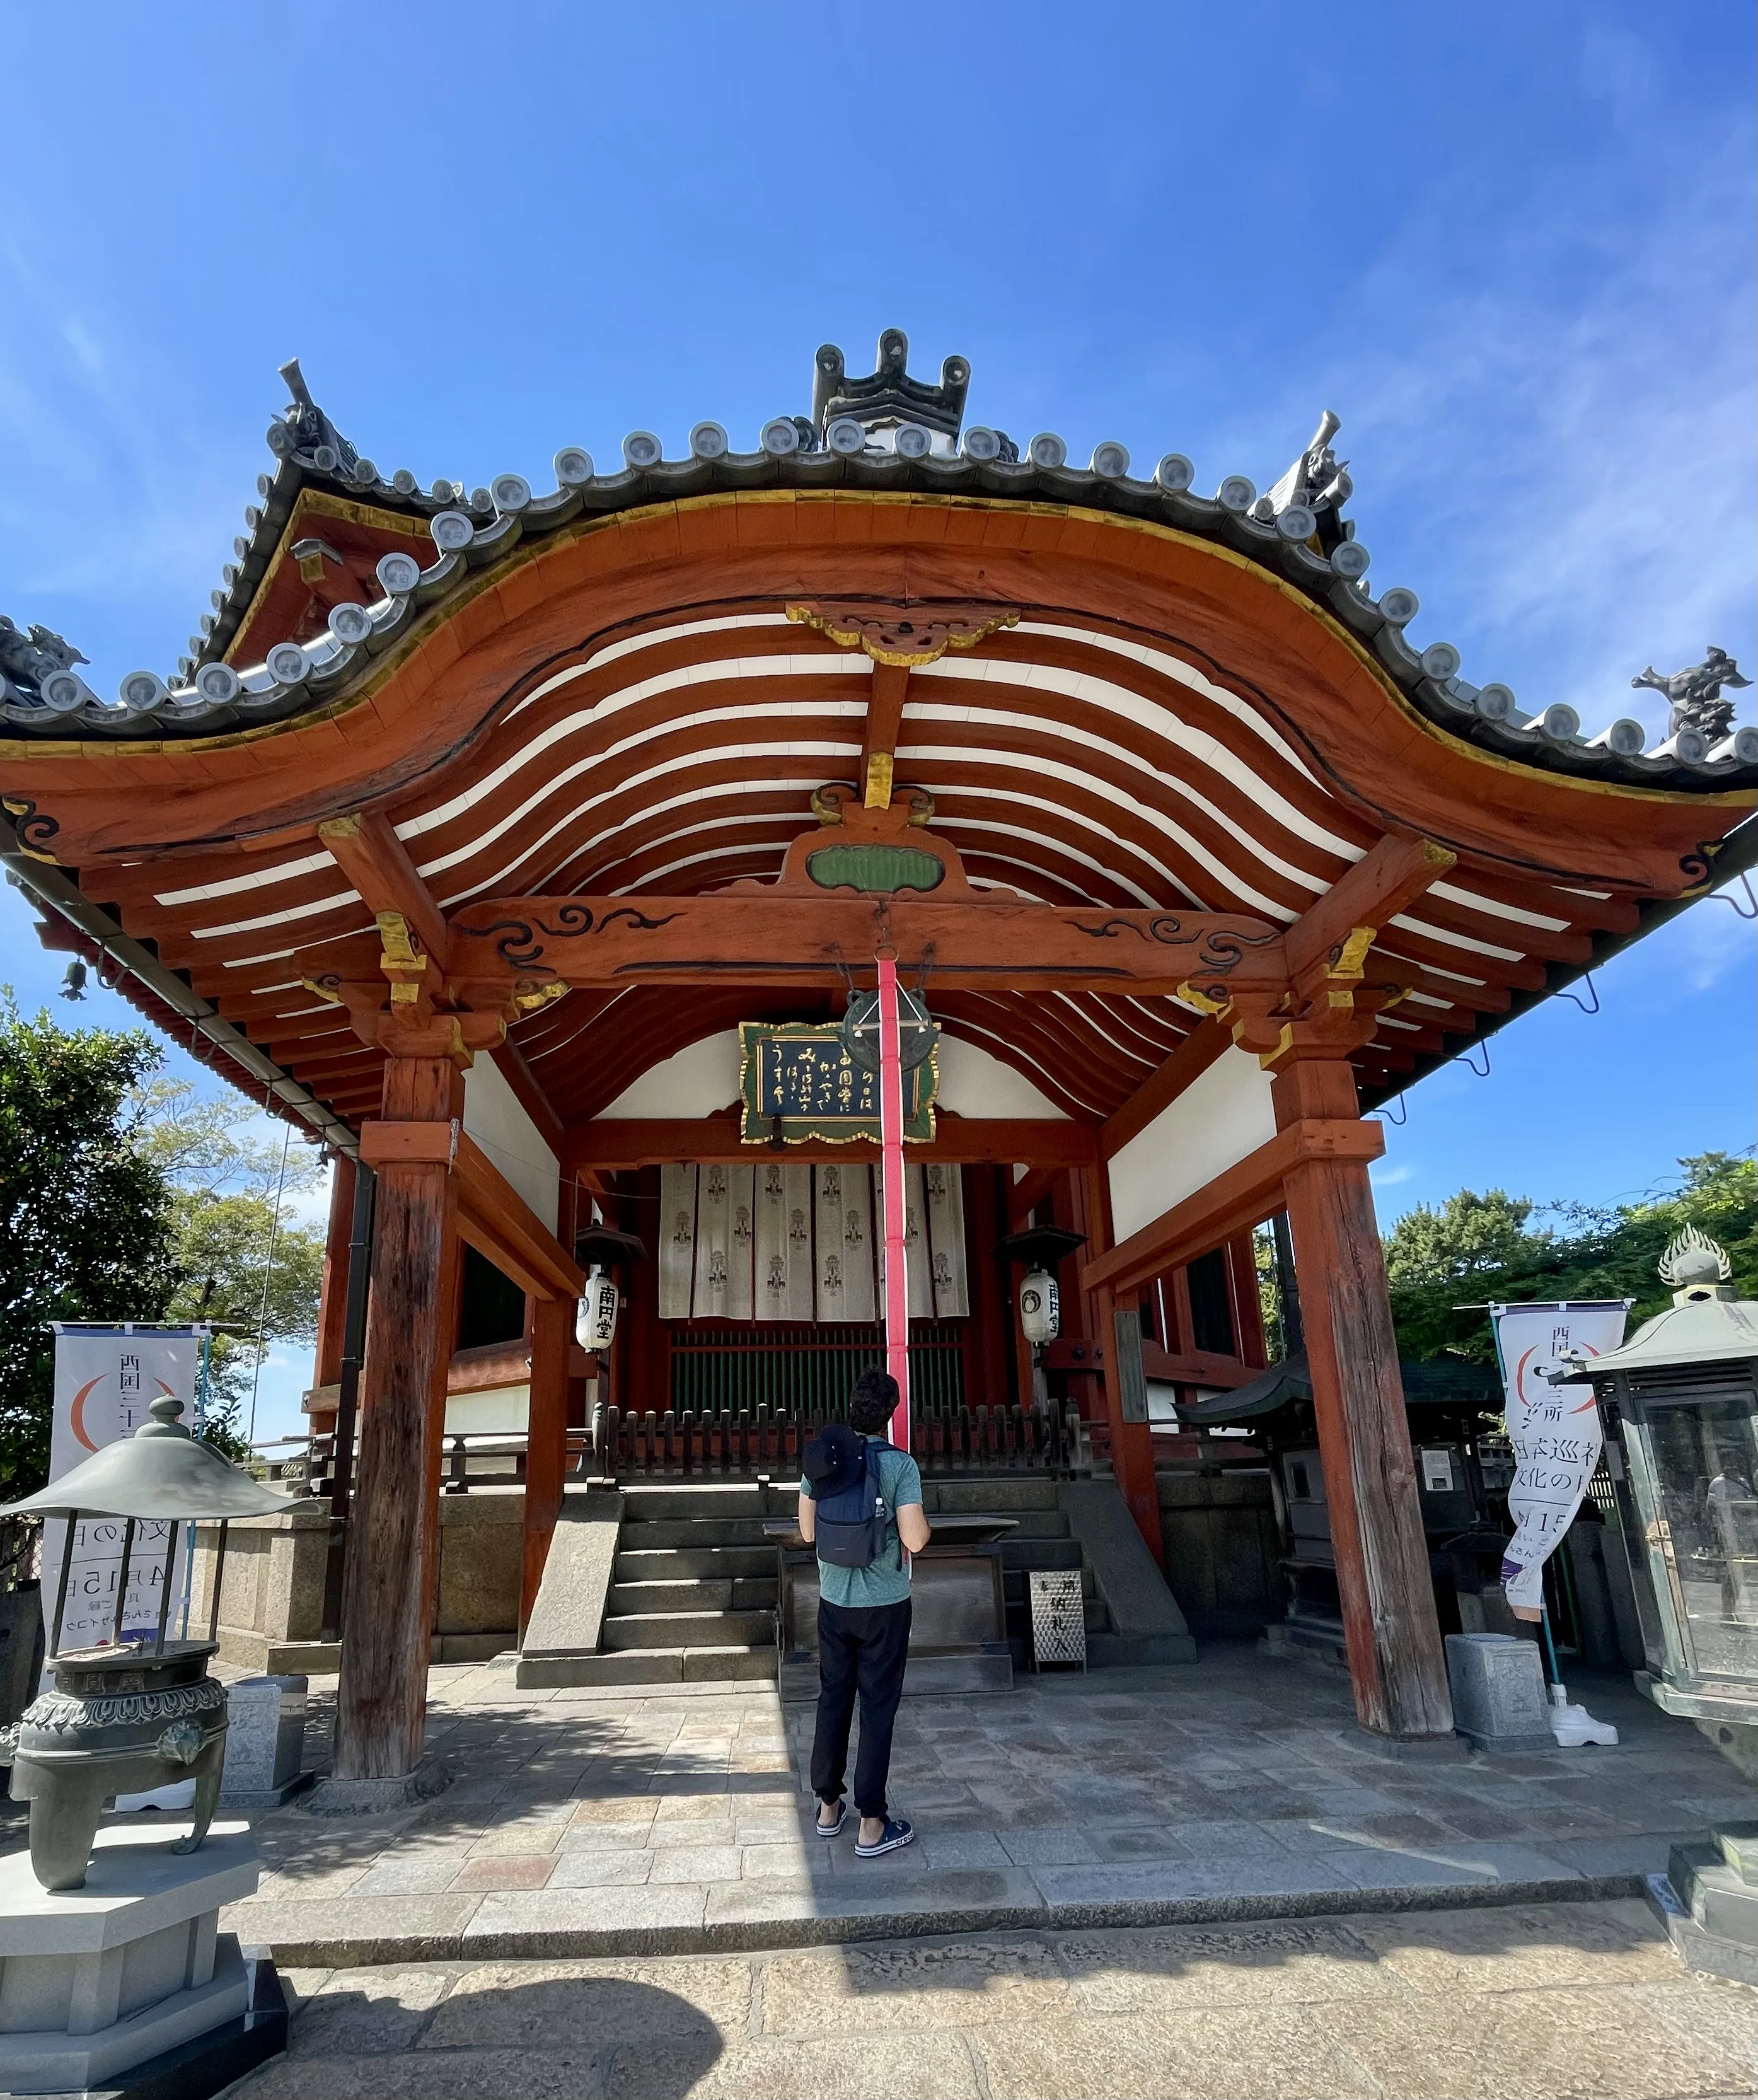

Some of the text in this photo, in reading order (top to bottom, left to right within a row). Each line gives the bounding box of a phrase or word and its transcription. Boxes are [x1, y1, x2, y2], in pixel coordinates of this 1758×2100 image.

[596, 1284, 615, 1340] 南円堂
[1542, 1325, 1571, 1422] 西国三三所
[1515, 1467, 1585, 1493] 文化の
